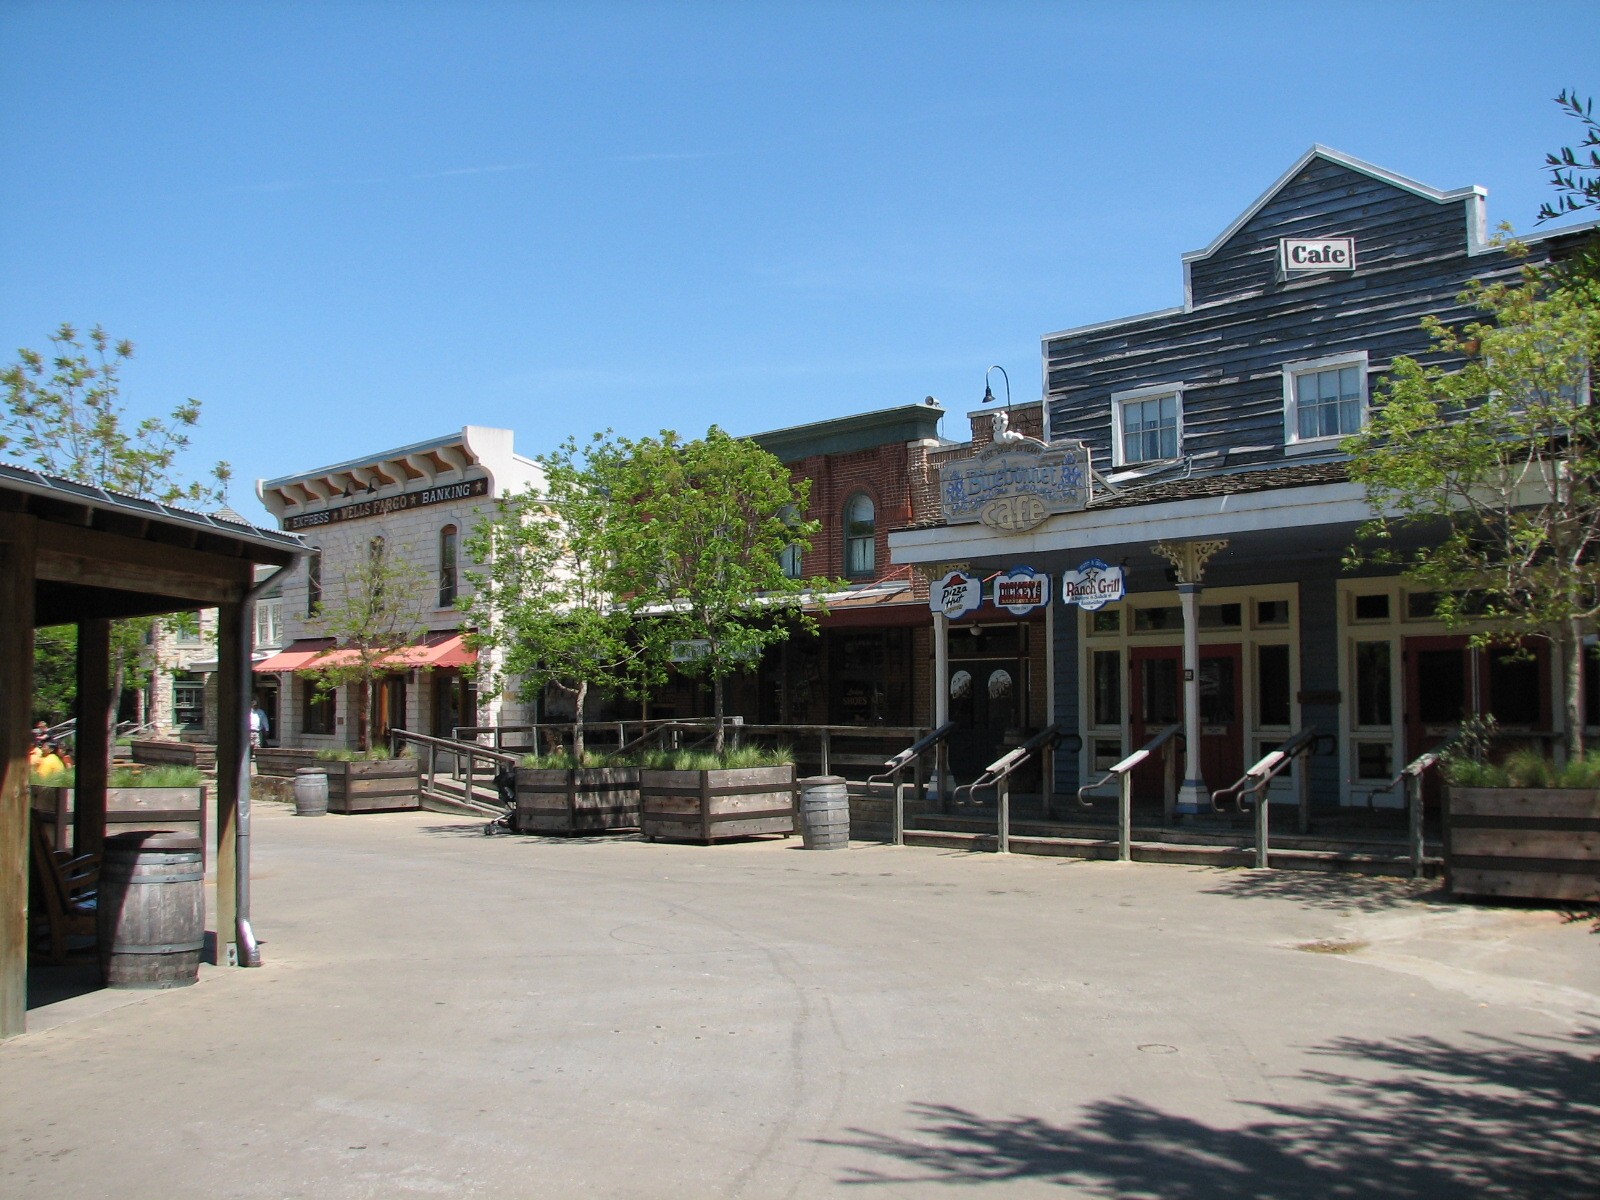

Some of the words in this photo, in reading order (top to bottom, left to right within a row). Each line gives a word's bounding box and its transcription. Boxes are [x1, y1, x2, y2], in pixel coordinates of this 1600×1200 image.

[1292, 245, 1346, 264] Cafe
[966, 459, 1057, 496] Bluebonnet
[293, 511, 330, 528] EXPRESS
[341, 502, 371, 520] WELLS
[373, 495, 407, 515] FARGO
[422, 483, 471, 504] BANKING
[941, 586, 967, 604] Pizza
[1066, 581, 1096, 596] Ranch
[1098, 578, 1120, 594] Grill
[945, 594, 965, 608] Hut
